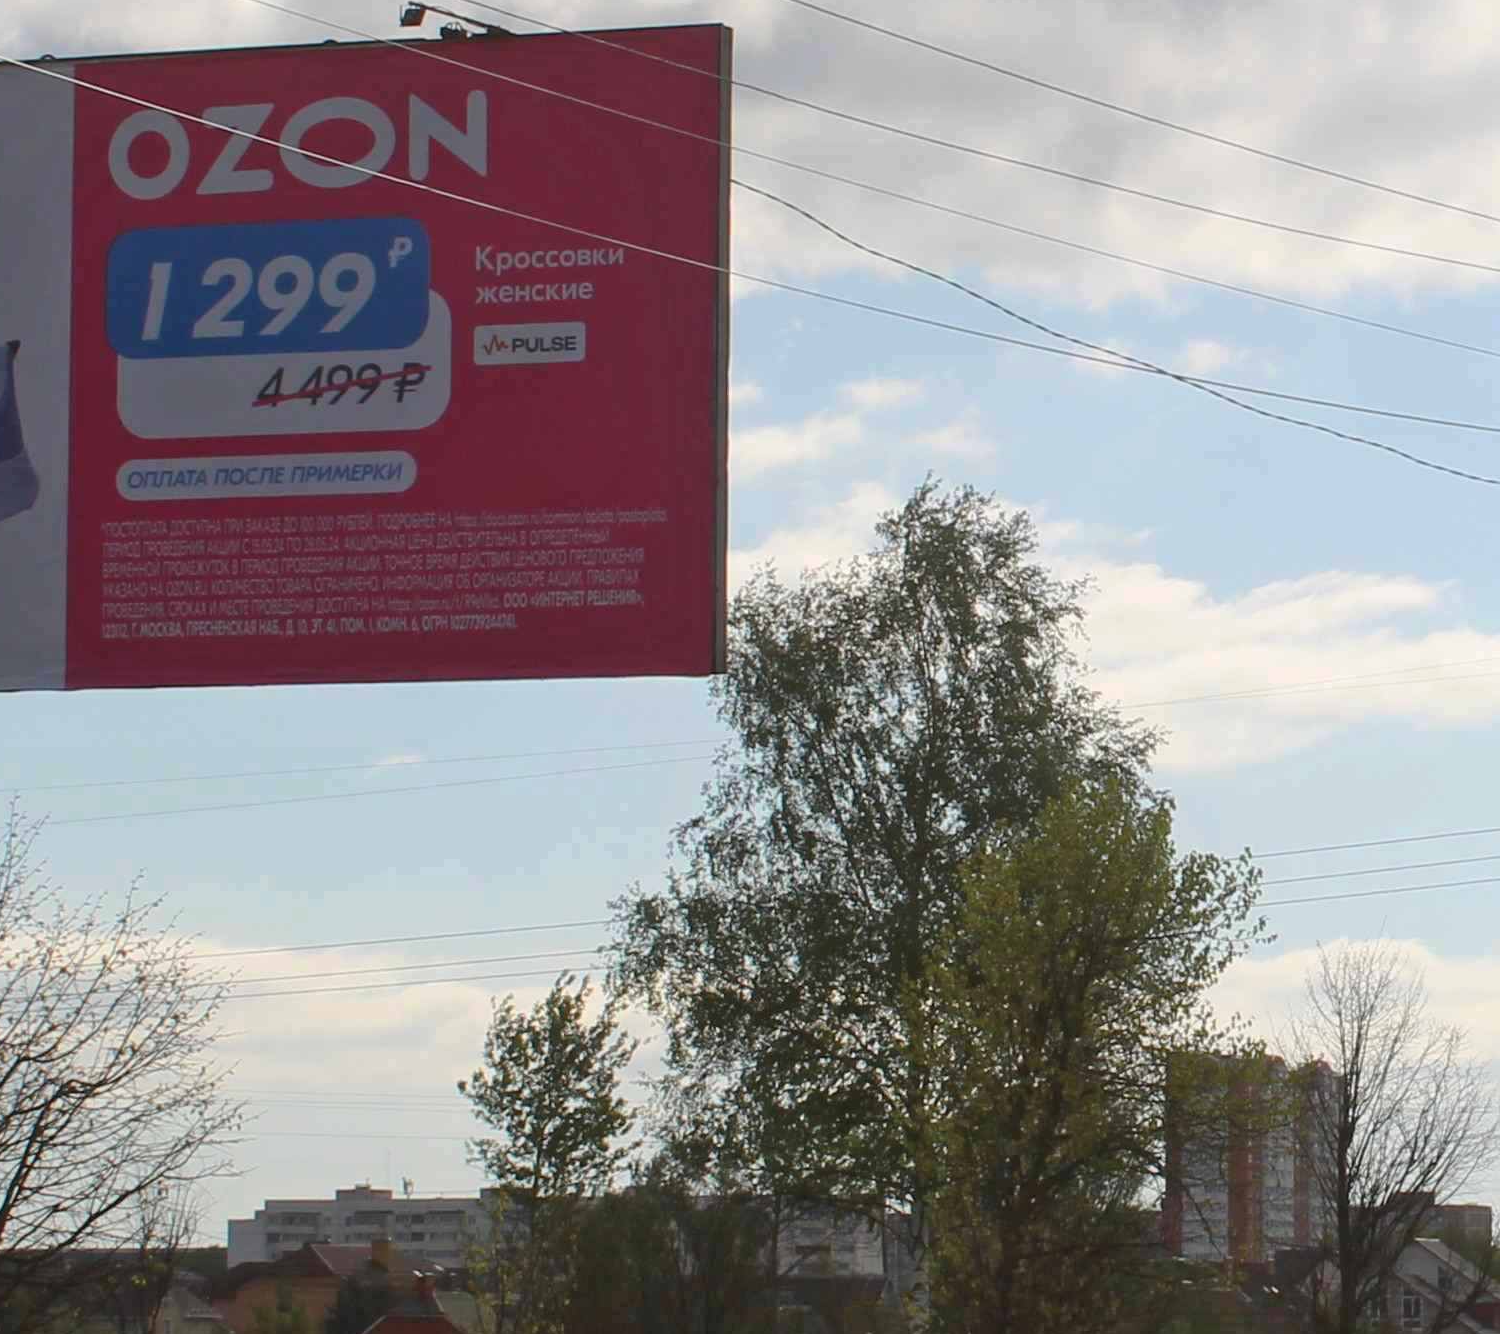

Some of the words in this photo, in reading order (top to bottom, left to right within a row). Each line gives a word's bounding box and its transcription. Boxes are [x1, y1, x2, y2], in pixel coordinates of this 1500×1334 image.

[108, 90, 488, 200] OZON
[475, 245, 625, 276] Кроссовки
[475, 282, 595, 304] женские
[511, 336, 577, 353] PULSE
[127, 470, 207, 489] ОПЛАТА
[213, 467, 285, 486] ПОСЛЕ
[290, 463, 403, 483] ПРИМЕРКИ
